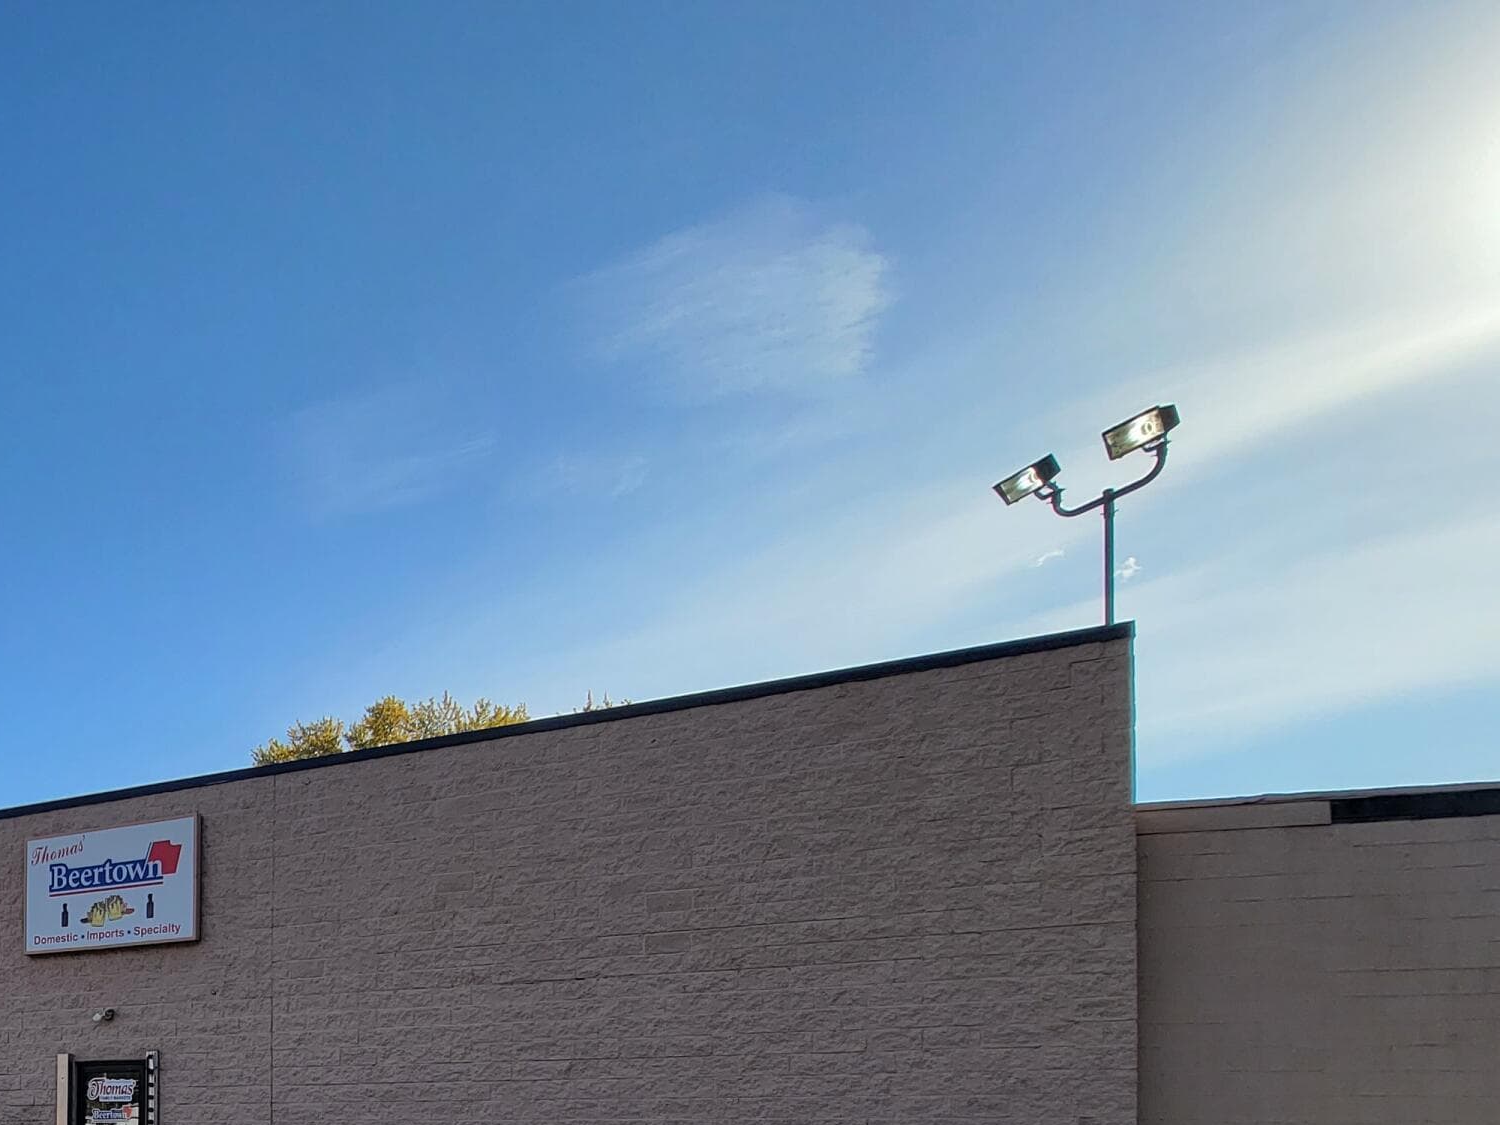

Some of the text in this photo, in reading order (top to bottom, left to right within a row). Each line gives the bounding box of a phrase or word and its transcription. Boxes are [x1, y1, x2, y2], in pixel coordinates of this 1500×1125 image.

[31, 835, 86, 865] Thomas'
[51, 859, 162, 890] Beertown
[34, 923, 181, 945] Domestic Imports Specialty
[90, 1079, 136, 1098] Thomas'
